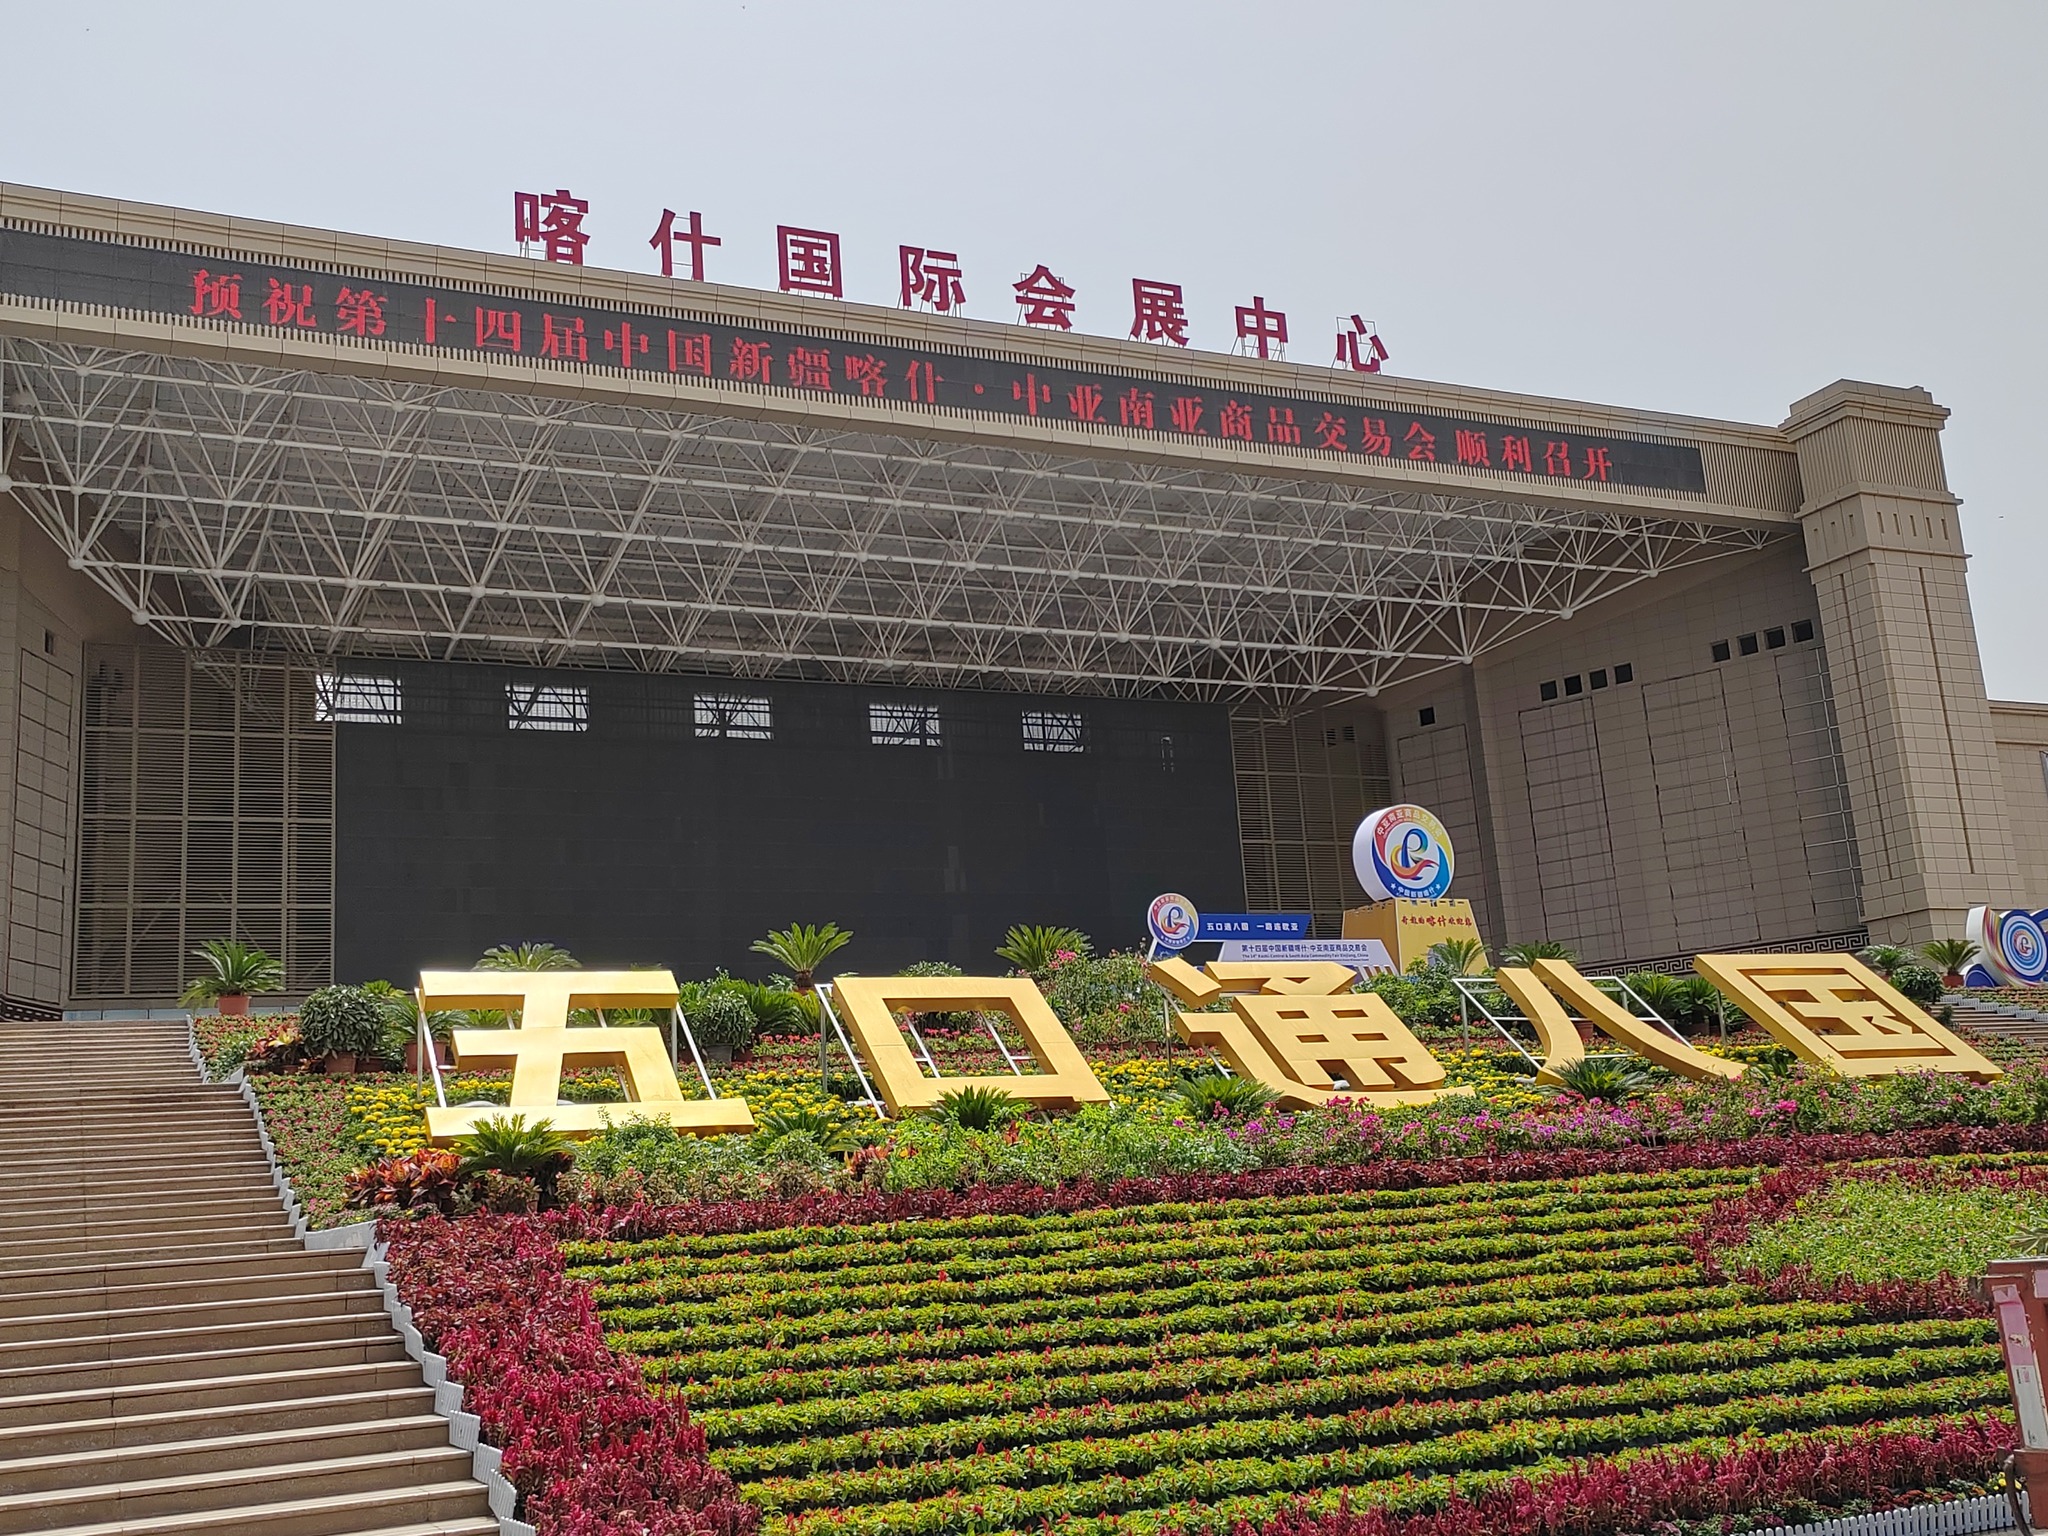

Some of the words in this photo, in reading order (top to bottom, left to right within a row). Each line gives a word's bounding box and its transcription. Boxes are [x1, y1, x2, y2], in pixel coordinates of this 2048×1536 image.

[514, 189, 1390, 374] 喀什国际会展中心
[1206, 922, 1249, 931] 五口通八国
[419, 953, 2004, 1147] 五口通八国
